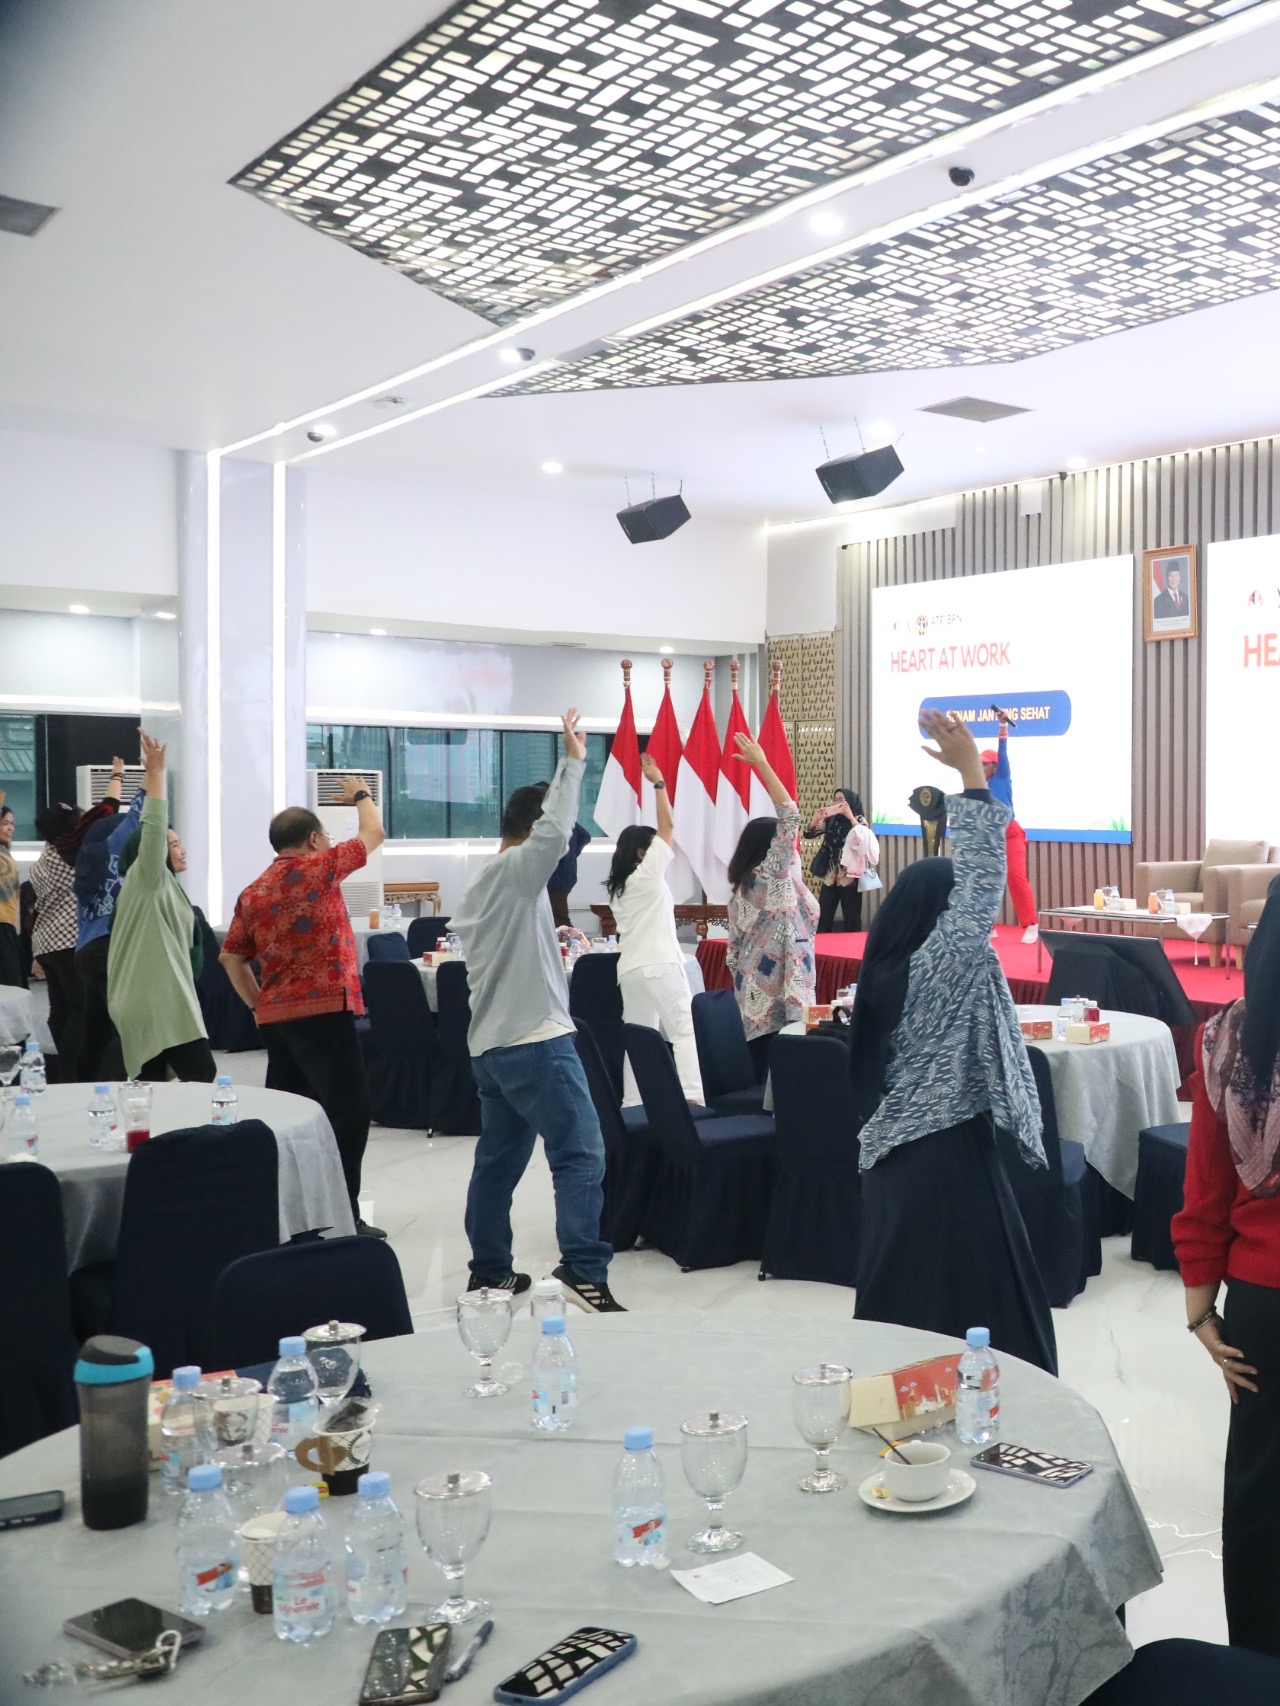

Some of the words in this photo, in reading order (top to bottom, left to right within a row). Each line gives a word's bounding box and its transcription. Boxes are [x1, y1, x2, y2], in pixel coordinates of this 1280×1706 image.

[931, 613, 962, 625] ATRBPN
[890, 648, 935, 673] HEART
[939, 646, 957, 670] AT
[960, 641, 1011, 668] WORK
[977, 707, 1019, 722] JANNG
[1020, 706, 1051, 720] SEHAT
